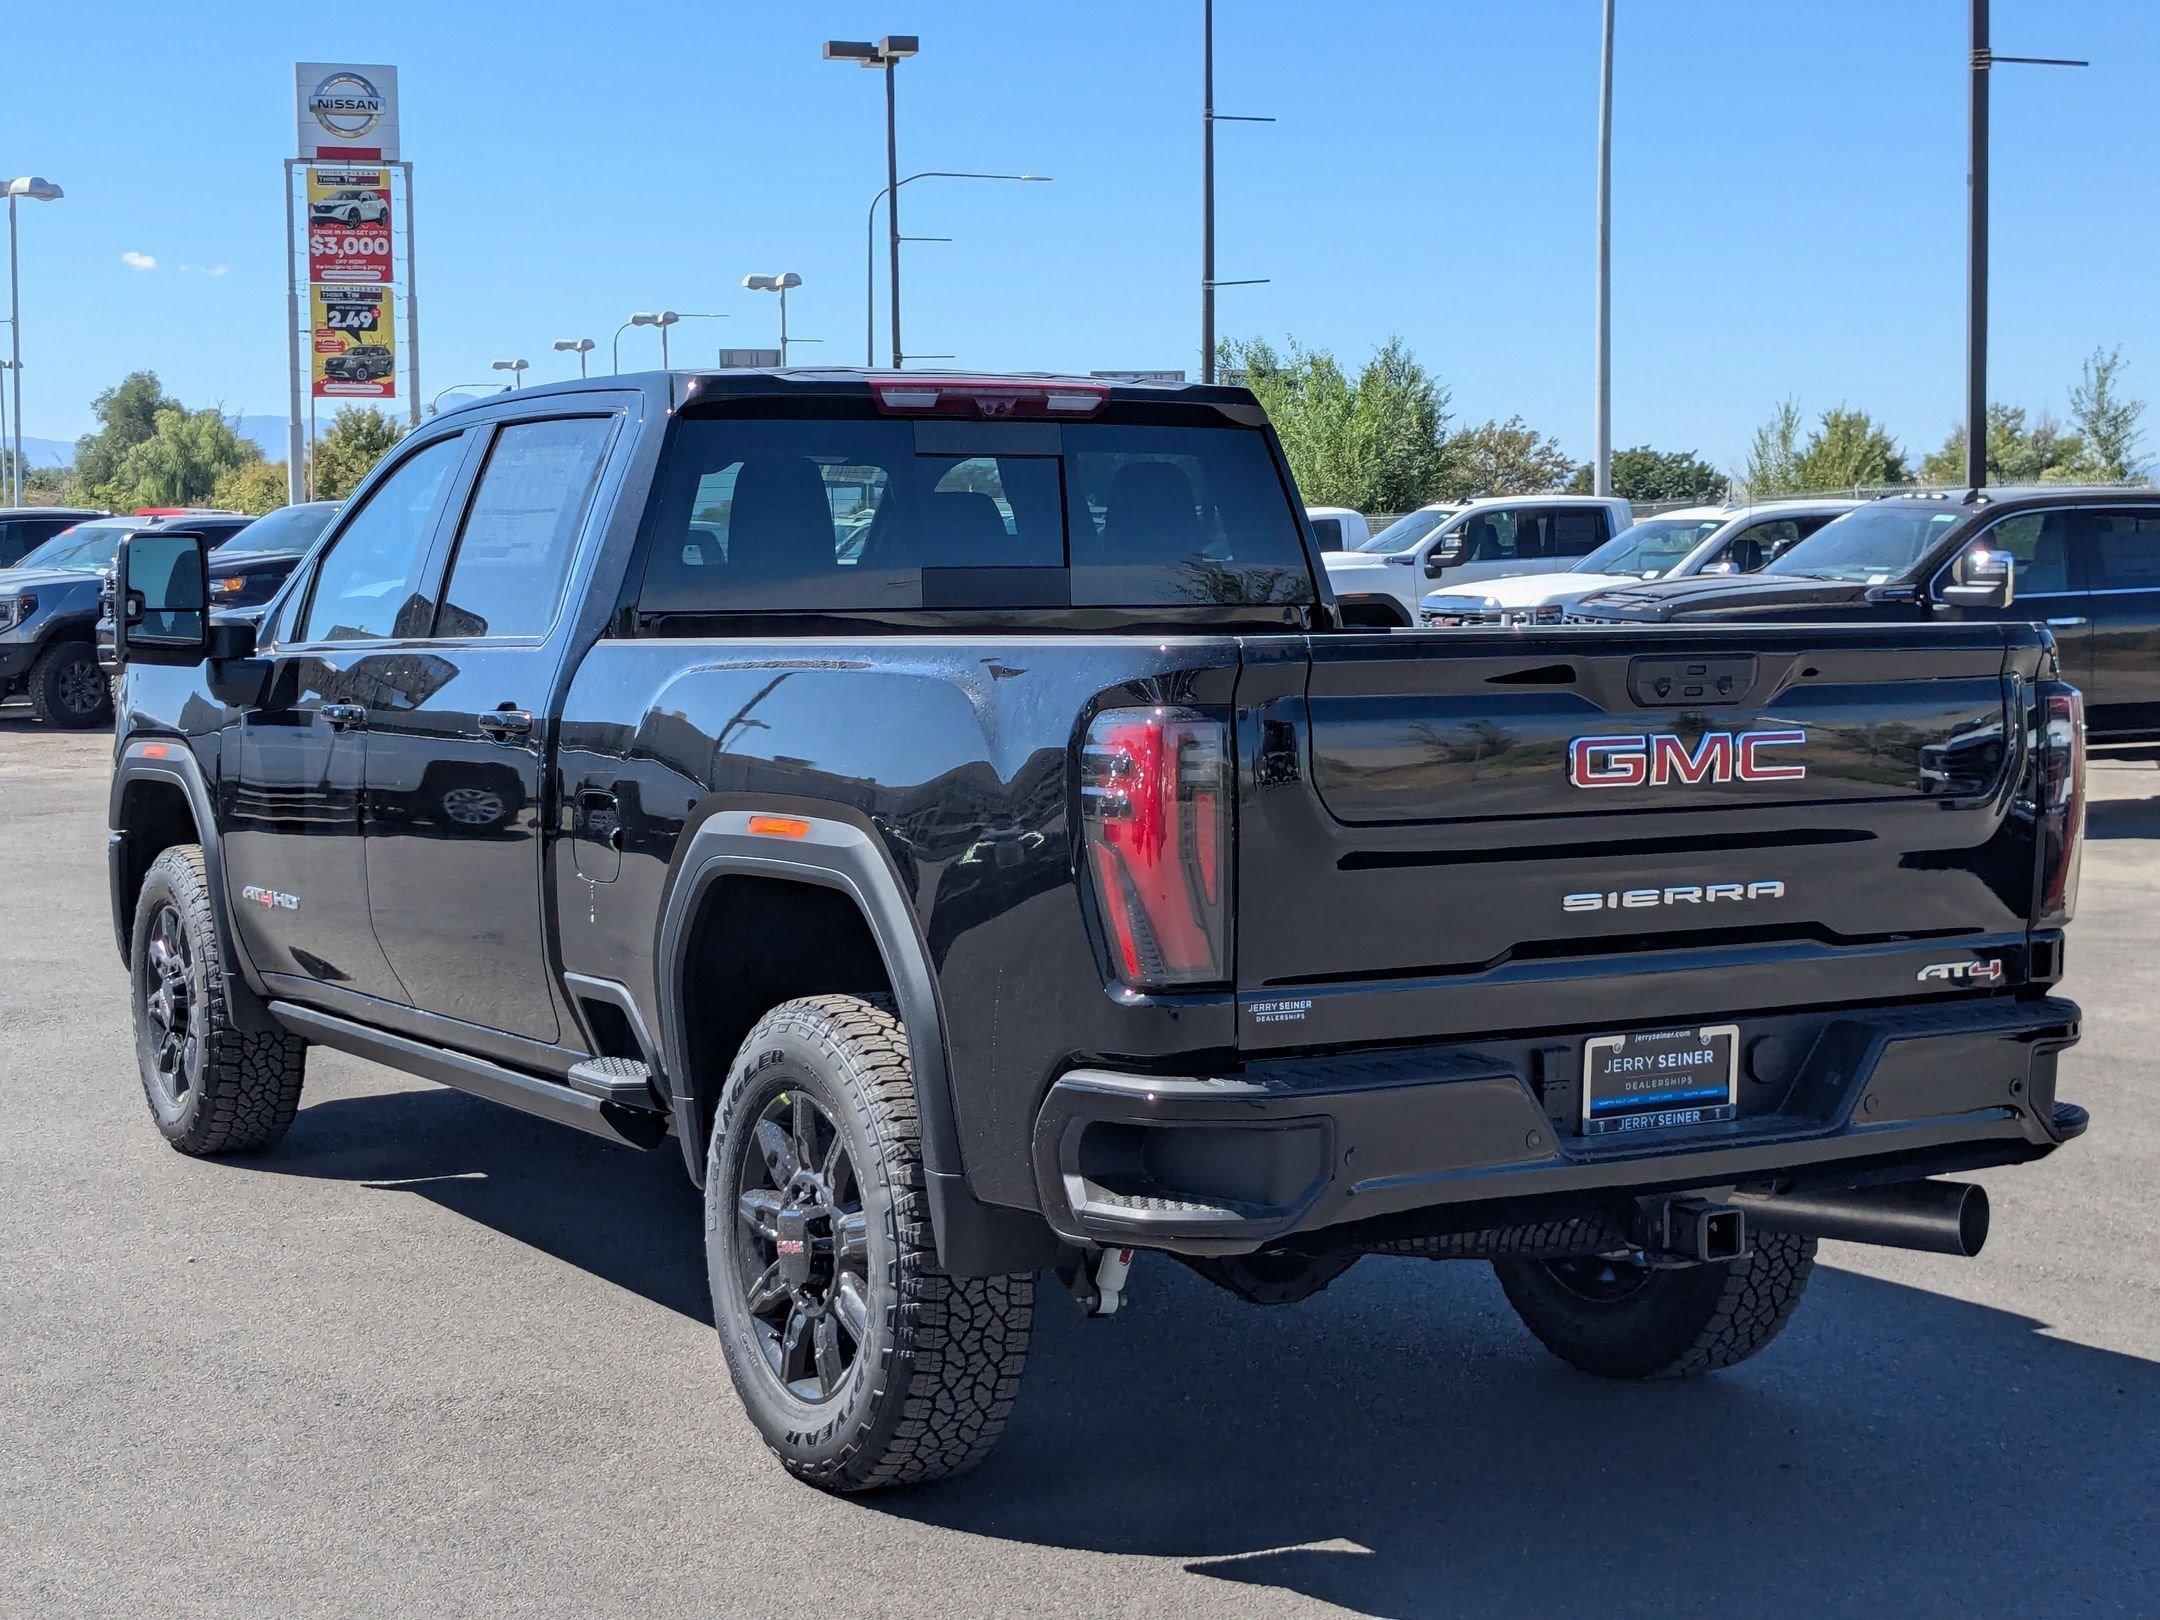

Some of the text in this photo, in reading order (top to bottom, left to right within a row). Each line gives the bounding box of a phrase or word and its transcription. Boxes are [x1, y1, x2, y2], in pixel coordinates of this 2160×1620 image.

[317, 98, 379, 111] NISSAN
[310, 234, 390, 258] $3,000
[328, 310, 373, 328] 2.49
[1569, 730, 1806, 788] GMC
[1562, 880, 1785, 912] SIERRA
[1917, 958, 2002, 981] AT4
[1248, 1000, 1312, 1013] JERRY SEINER
[1255, 1012, 1305, 1023] DEALERSHIPS
[1635, 1030, 1691, 1043] jerryseiner.com
[1604, 1050, 1714, 1073] JERRY SEINER
[1625, 1075, 1693, 1091] DEALERSHIPS
[1618, 1110, 1701, 1131] JERRY SEINER
